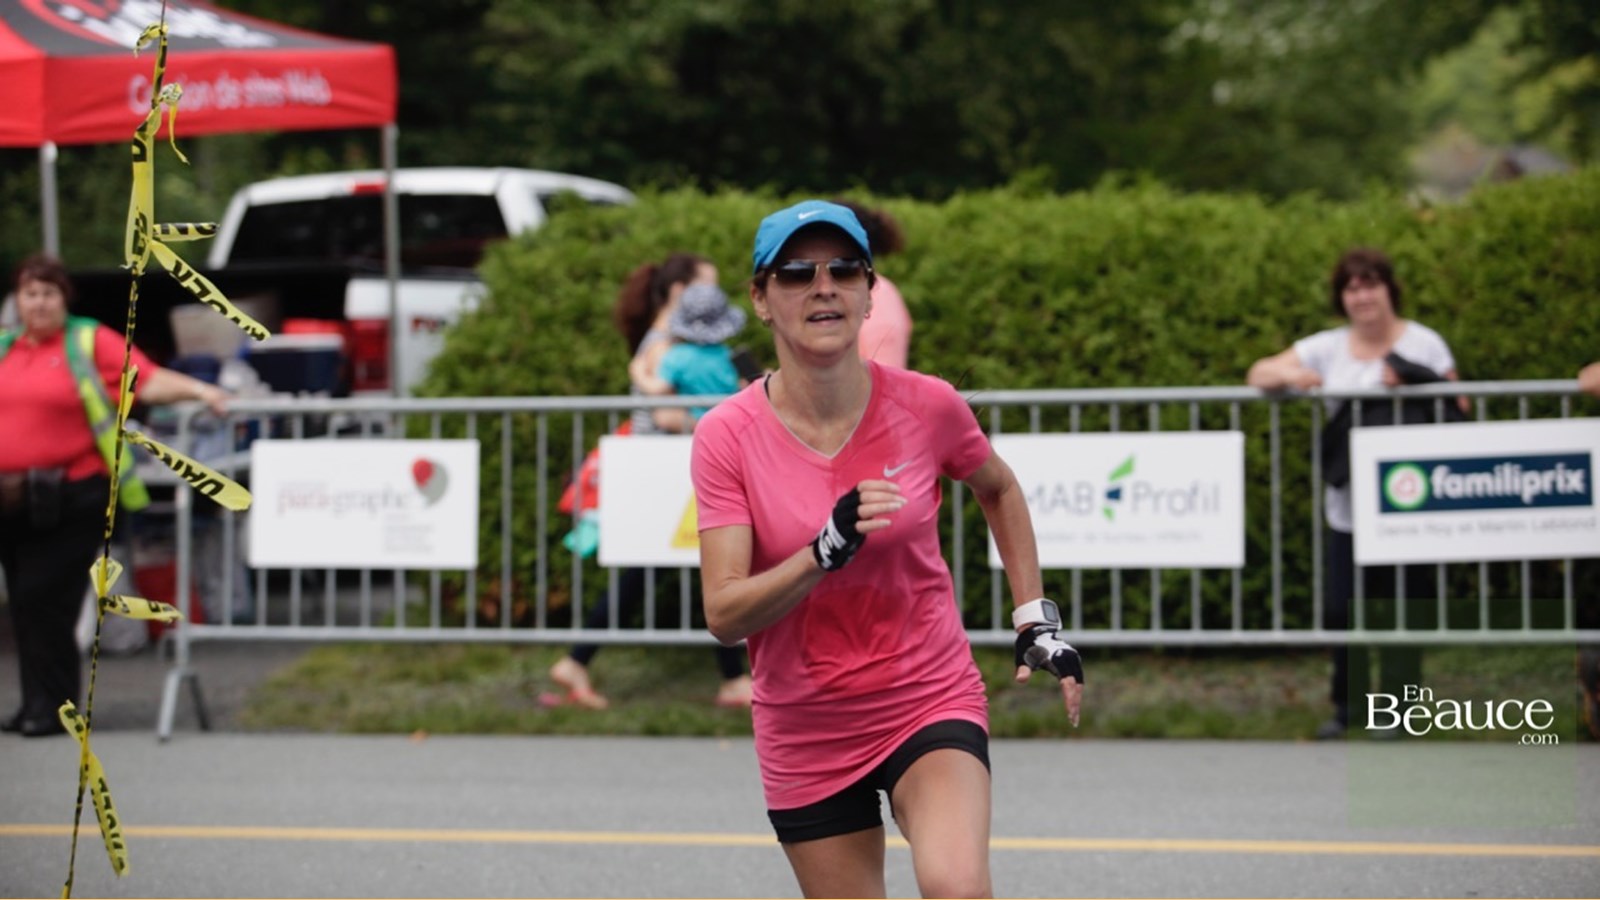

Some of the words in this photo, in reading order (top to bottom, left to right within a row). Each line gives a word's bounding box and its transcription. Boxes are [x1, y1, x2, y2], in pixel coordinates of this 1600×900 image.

[214, 71, 243, 109] de
[1130, 480, 1222, 516] Profil
[1431, 462, 1586, 504] familiprix
